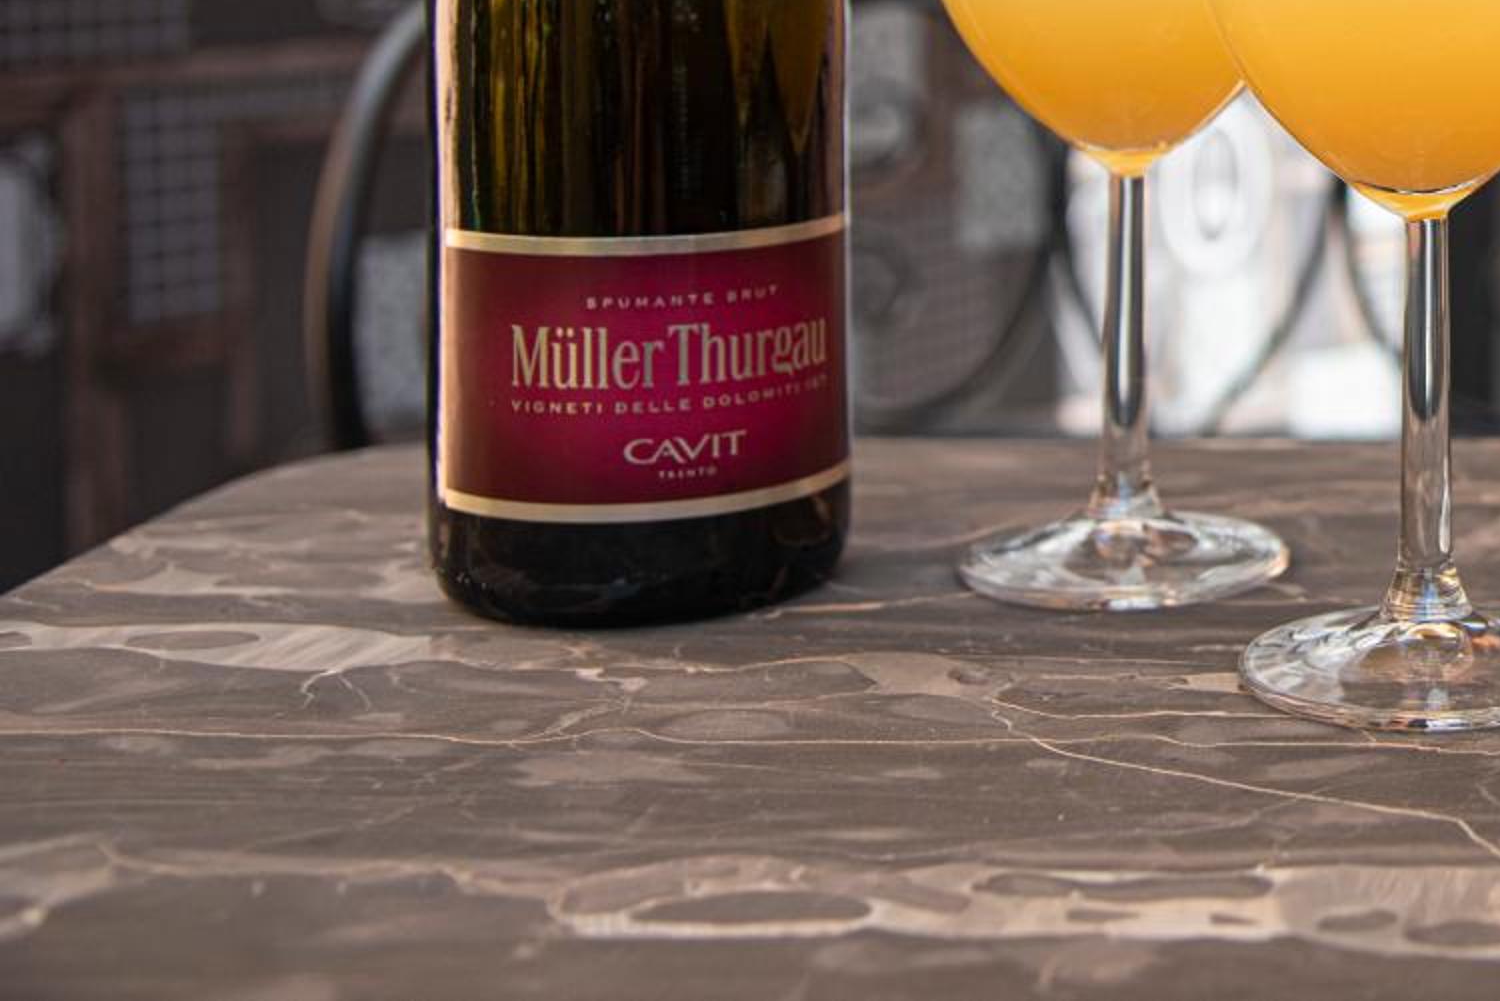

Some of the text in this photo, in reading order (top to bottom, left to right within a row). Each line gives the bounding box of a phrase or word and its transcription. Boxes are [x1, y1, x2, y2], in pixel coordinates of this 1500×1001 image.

[585, 283, 779, 310] SPUMANTE BRUT
[511, 317, 828, 390] Müller Thurgau
[511, 400, 604, 415] VIGNETI
[613, 398, 692, 415] DELLE
[702, 383, 800, 410] DOLOMITI
[622, 429, 748, 466] CAVIT
